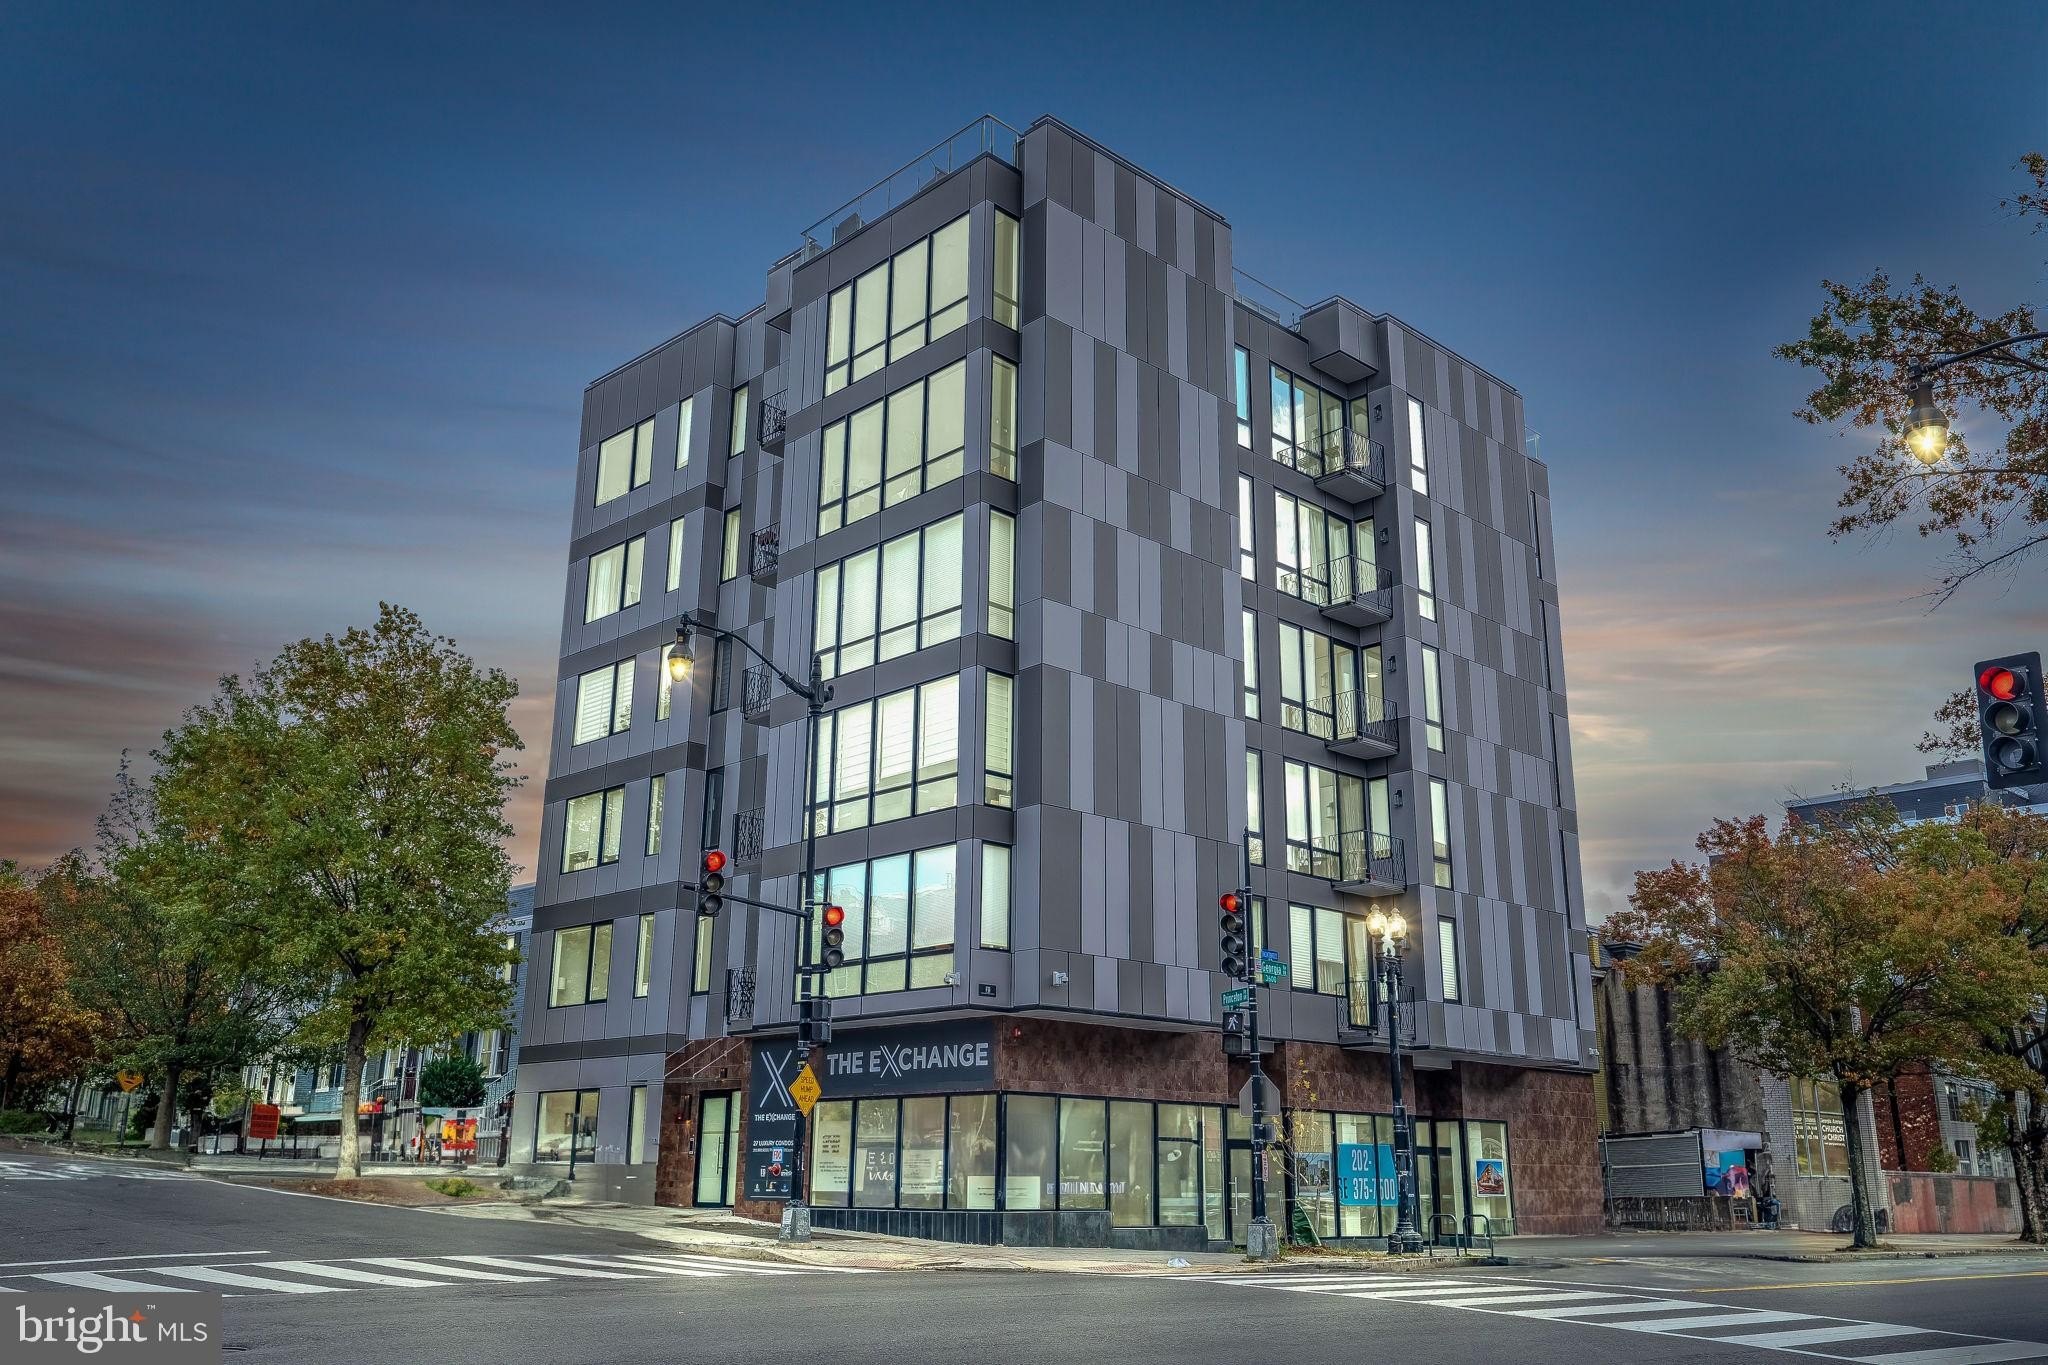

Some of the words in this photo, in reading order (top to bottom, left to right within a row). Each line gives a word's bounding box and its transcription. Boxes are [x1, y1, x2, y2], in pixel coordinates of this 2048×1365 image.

[1223, 991, 1243, 1006] Princeton
[827, 1051, 863, 1075] THE
[869, 1043, 989, 1078] EXCHANGE
[801, 1076, 814, 1084] SPEED
[800, 1095, 814, 1103] AHEAD
[755, 1113, 765, 1121] THE
[766, 1112, 796, 1122] EXCHANGE
[1821, 1125, 1843, 1133] CHURCH
[1352, 1149, 1372, 1171] 202-
